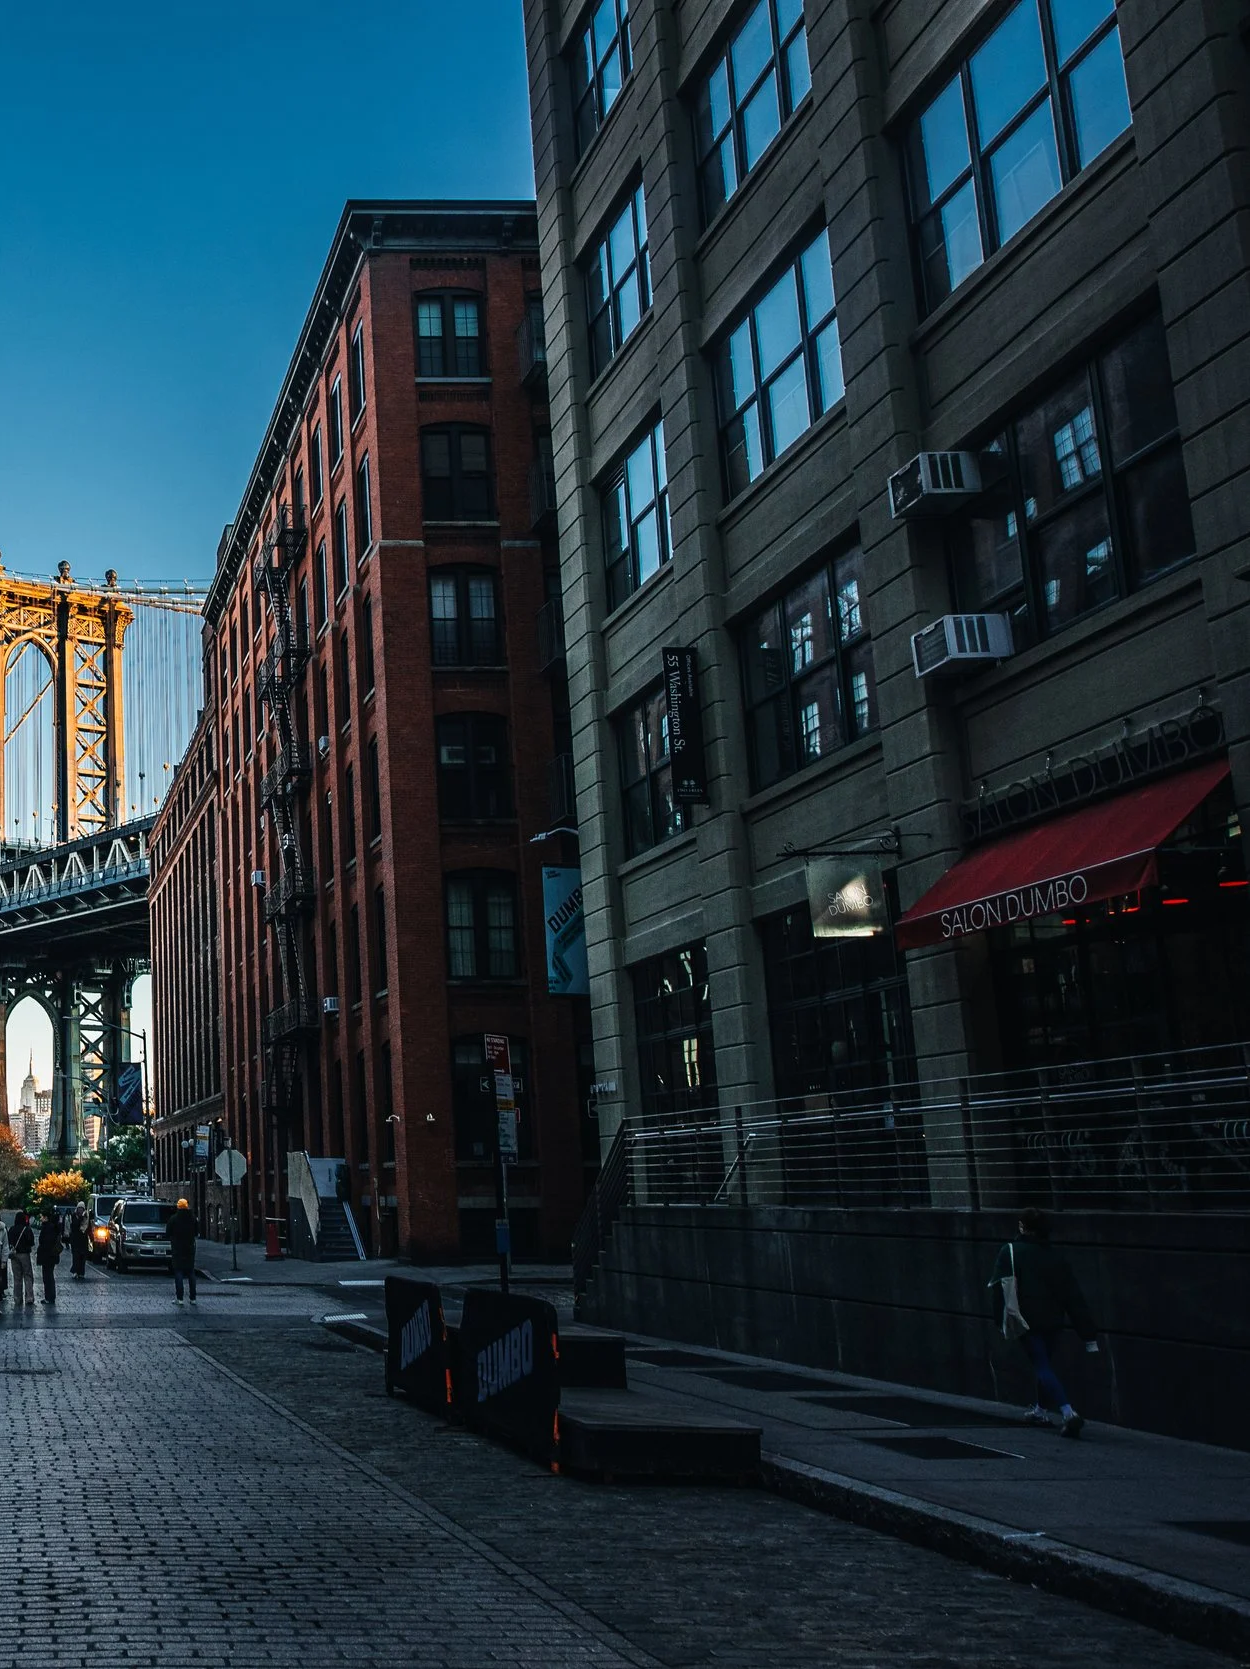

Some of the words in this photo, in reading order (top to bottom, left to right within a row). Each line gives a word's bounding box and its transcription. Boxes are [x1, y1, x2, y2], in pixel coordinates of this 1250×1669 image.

[666, 654, 679, 667] 55
[668, 671, 682, 735] Washington
[673, 739, 686, 753] St.
[958, 770, 1061, 840] SALON
[1068, 705, 1224, 800] DUMBO
[828, 895, 874, 917] DUMBO
[940, 899, 1001, 938] SALON
[1006, 874, 1088, 922] DUMBO
[476, 1318, 535, 1403] DUMBO
